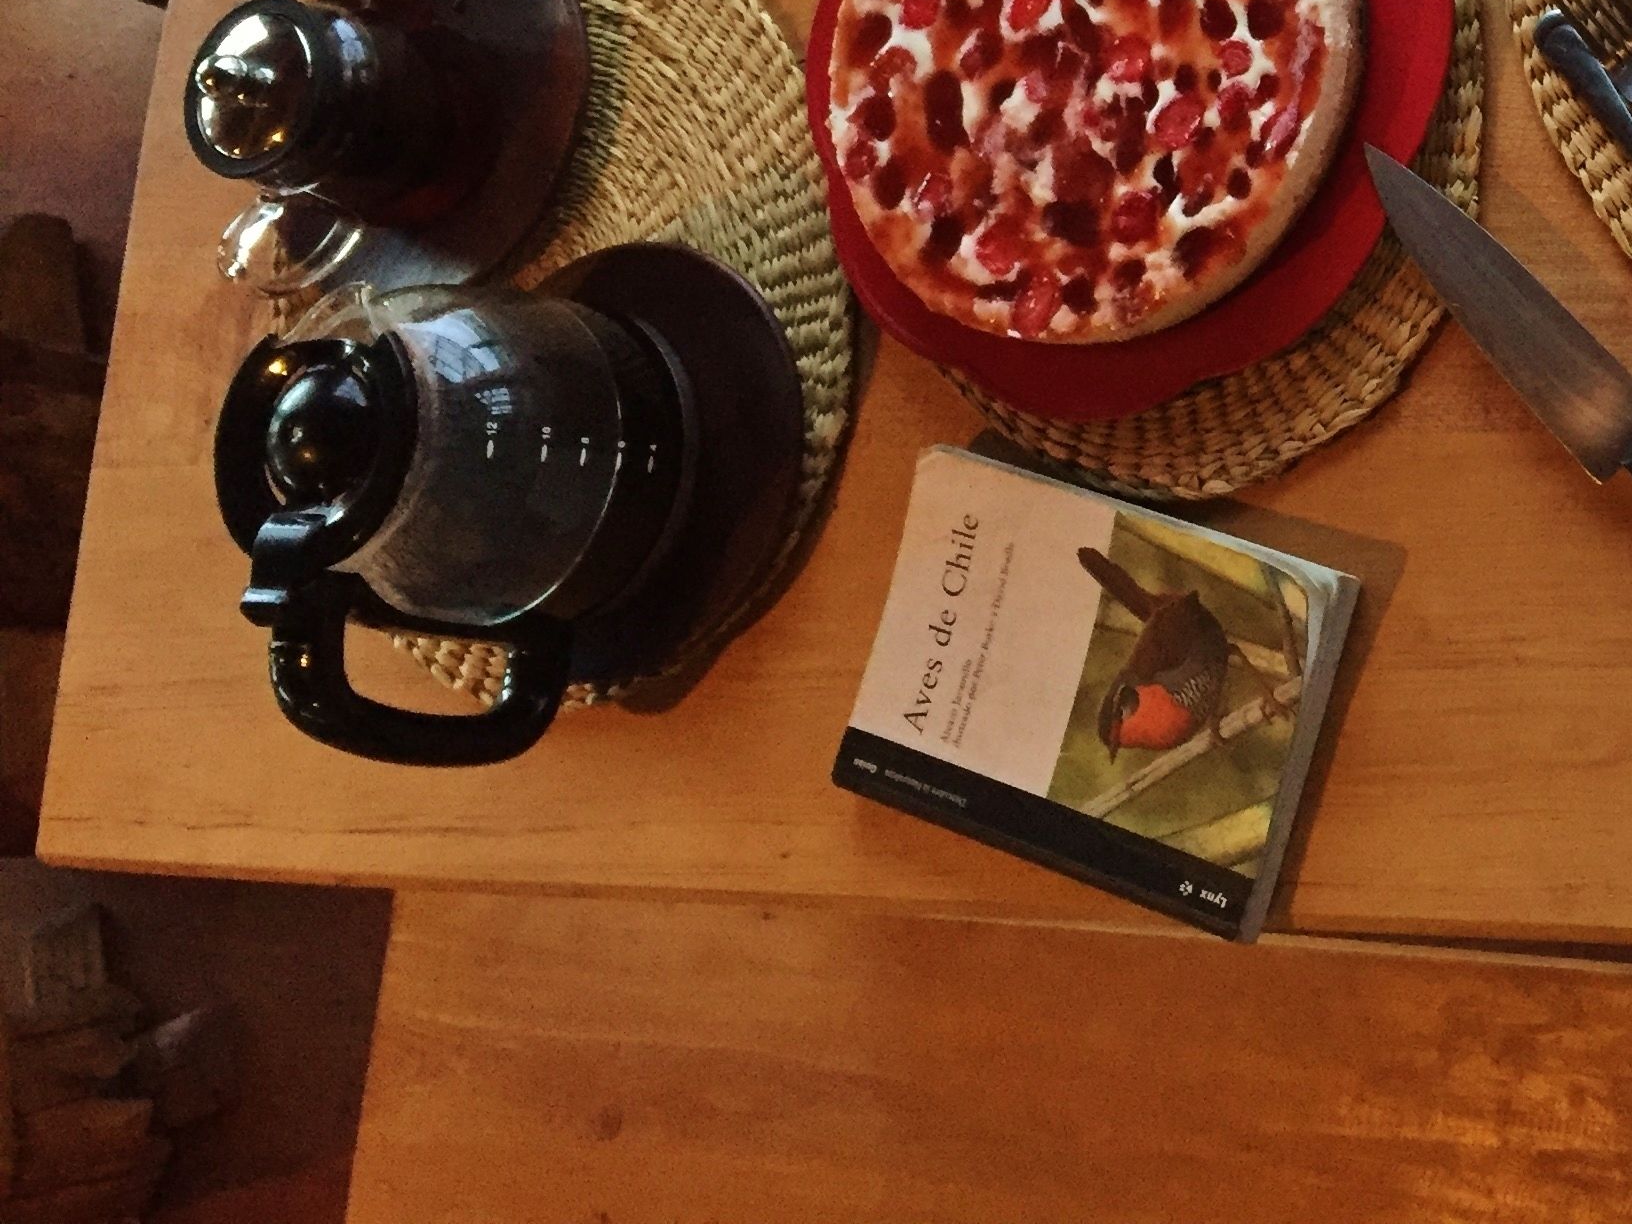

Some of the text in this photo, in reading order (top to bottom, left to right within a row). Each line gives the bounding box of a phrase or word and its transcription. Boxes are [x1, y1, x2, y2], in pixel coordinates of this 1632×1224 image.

[486, 421, 498, 436] 12
[541, 426, 551, 440] 10
[903, 513, 980, 736] Aves de Chile
[1199, 889, 1228, 908] Lynx
